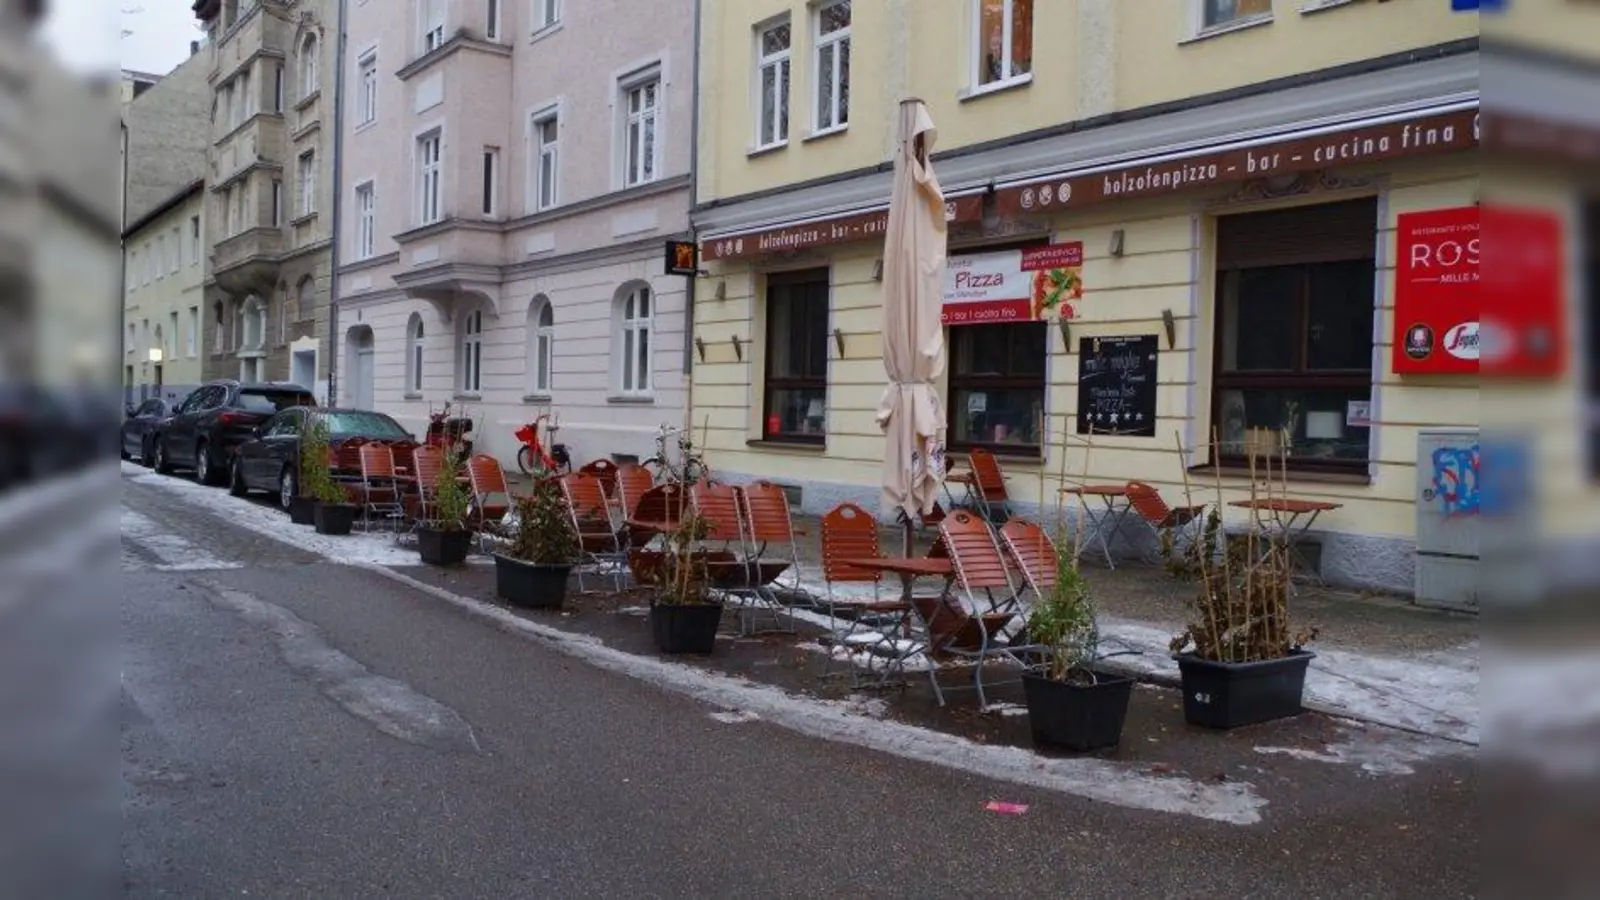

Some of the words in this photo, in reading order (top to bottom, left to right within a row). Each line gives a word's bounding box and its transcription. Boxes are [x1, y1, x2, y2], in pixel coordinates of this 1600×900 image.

[1103, 163, 1217, 195] holzofenpizza
[1246, 151, 1280, 173] bar
[1313, 136, 1390, 162] cucina
[1402, 124, 1454, 148] fina
[831, 223, 849, 239] bar
[955, 271, 1004, 288] Pizza
